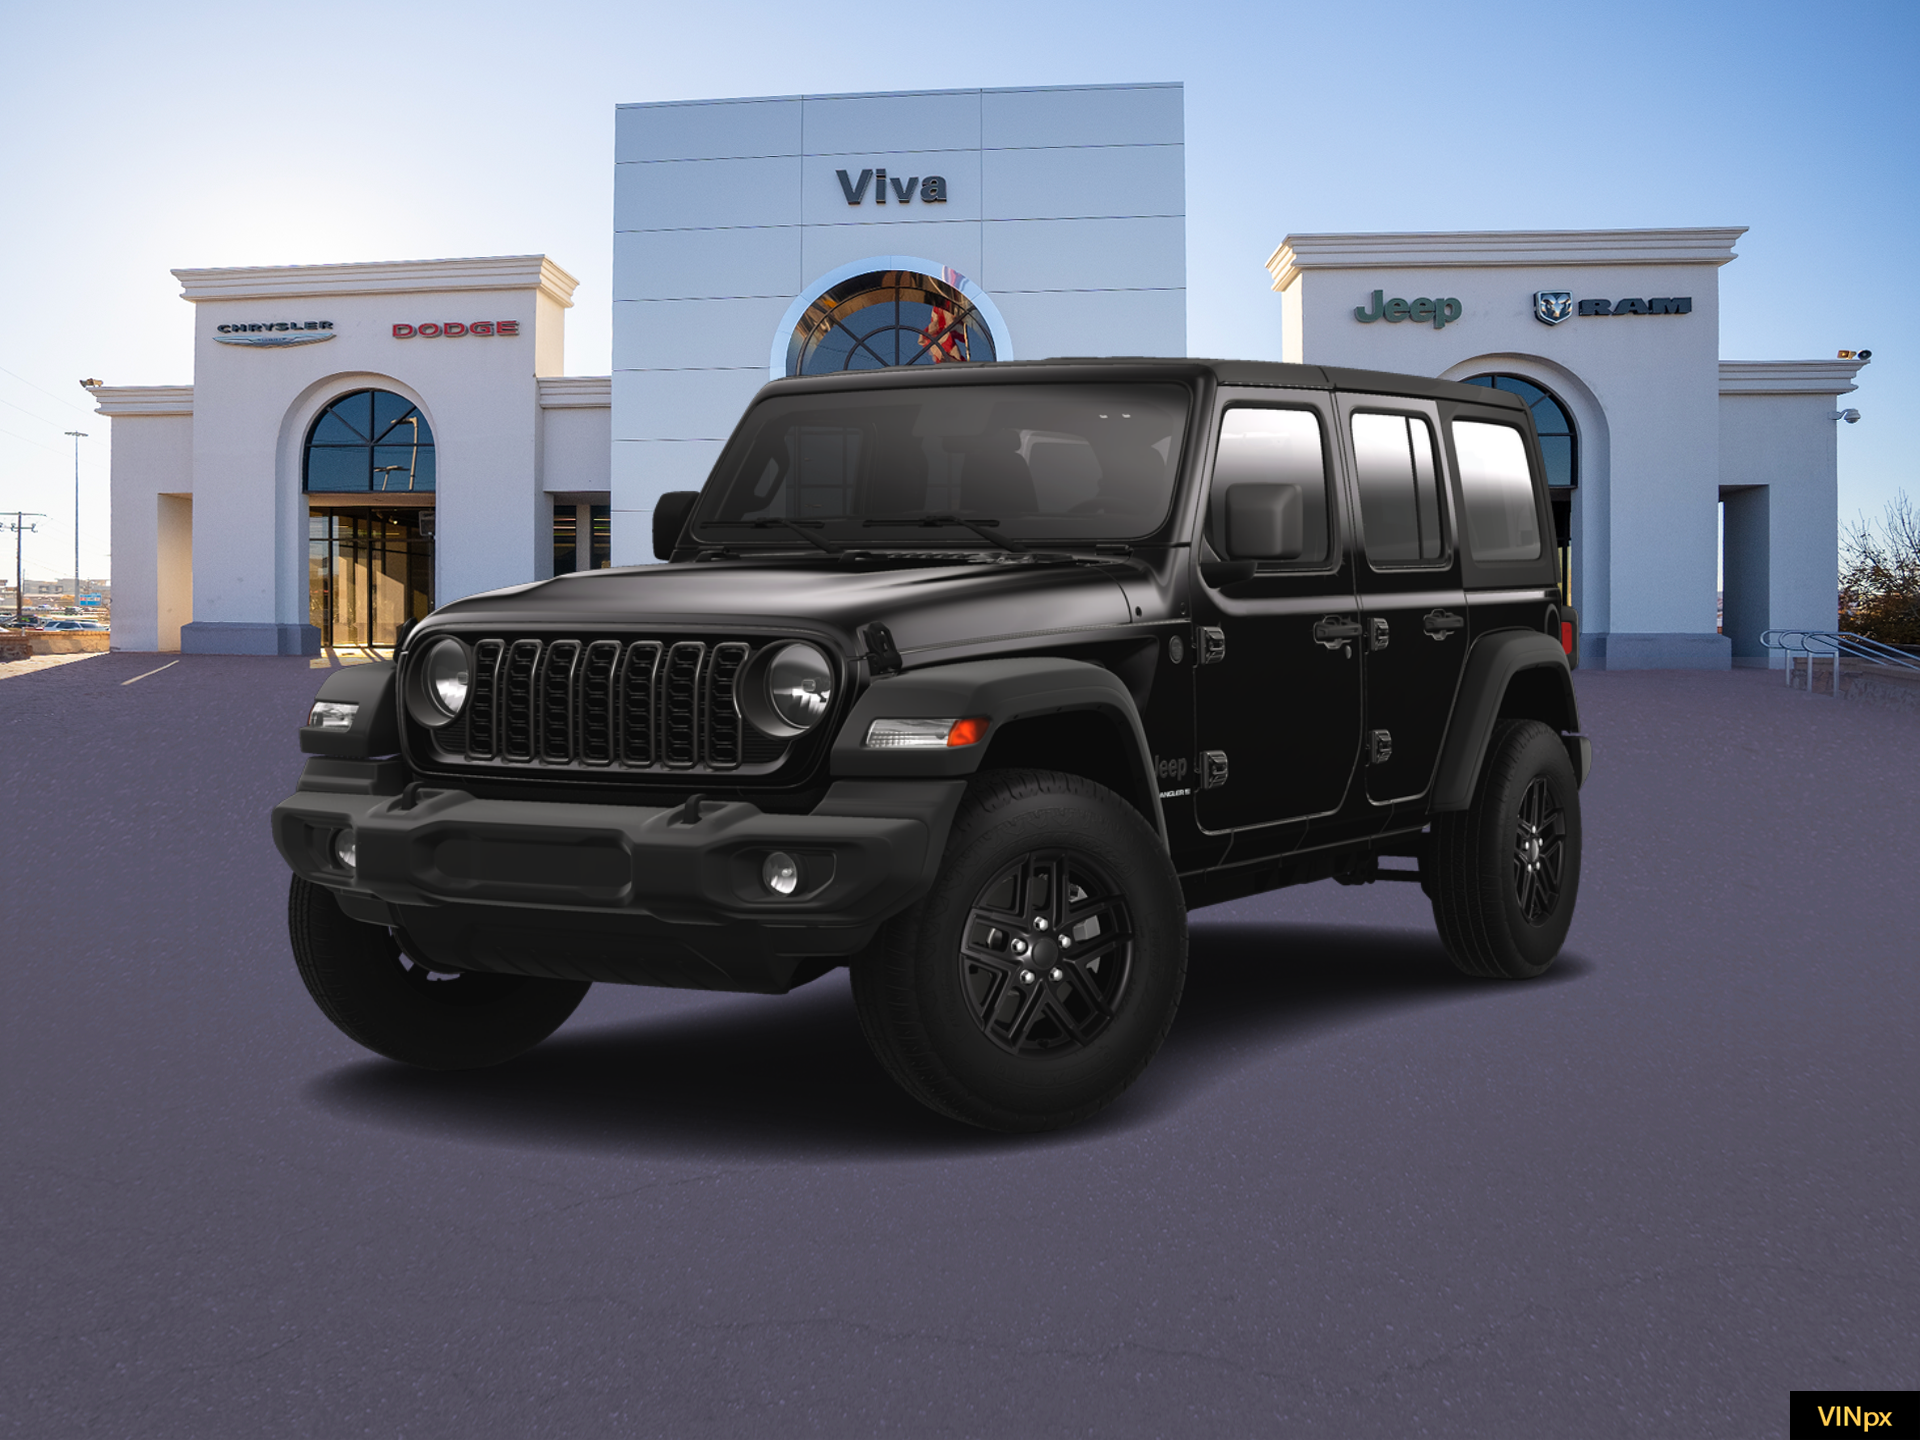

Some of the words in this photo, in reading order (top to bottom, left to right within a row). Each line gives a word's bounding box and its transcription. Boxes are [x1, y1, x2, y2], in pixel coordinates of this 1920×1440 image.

[835, 168, 948, 205] Viva
[1354, 289, 1463, 329] Jeep
[1578, 296, 1693, 317] RAM
[216, 320, 334, 334] CHRYSLER
[391, 320, 520, 339] DODGE
[1154, 754, 1188, 781] Jeep
